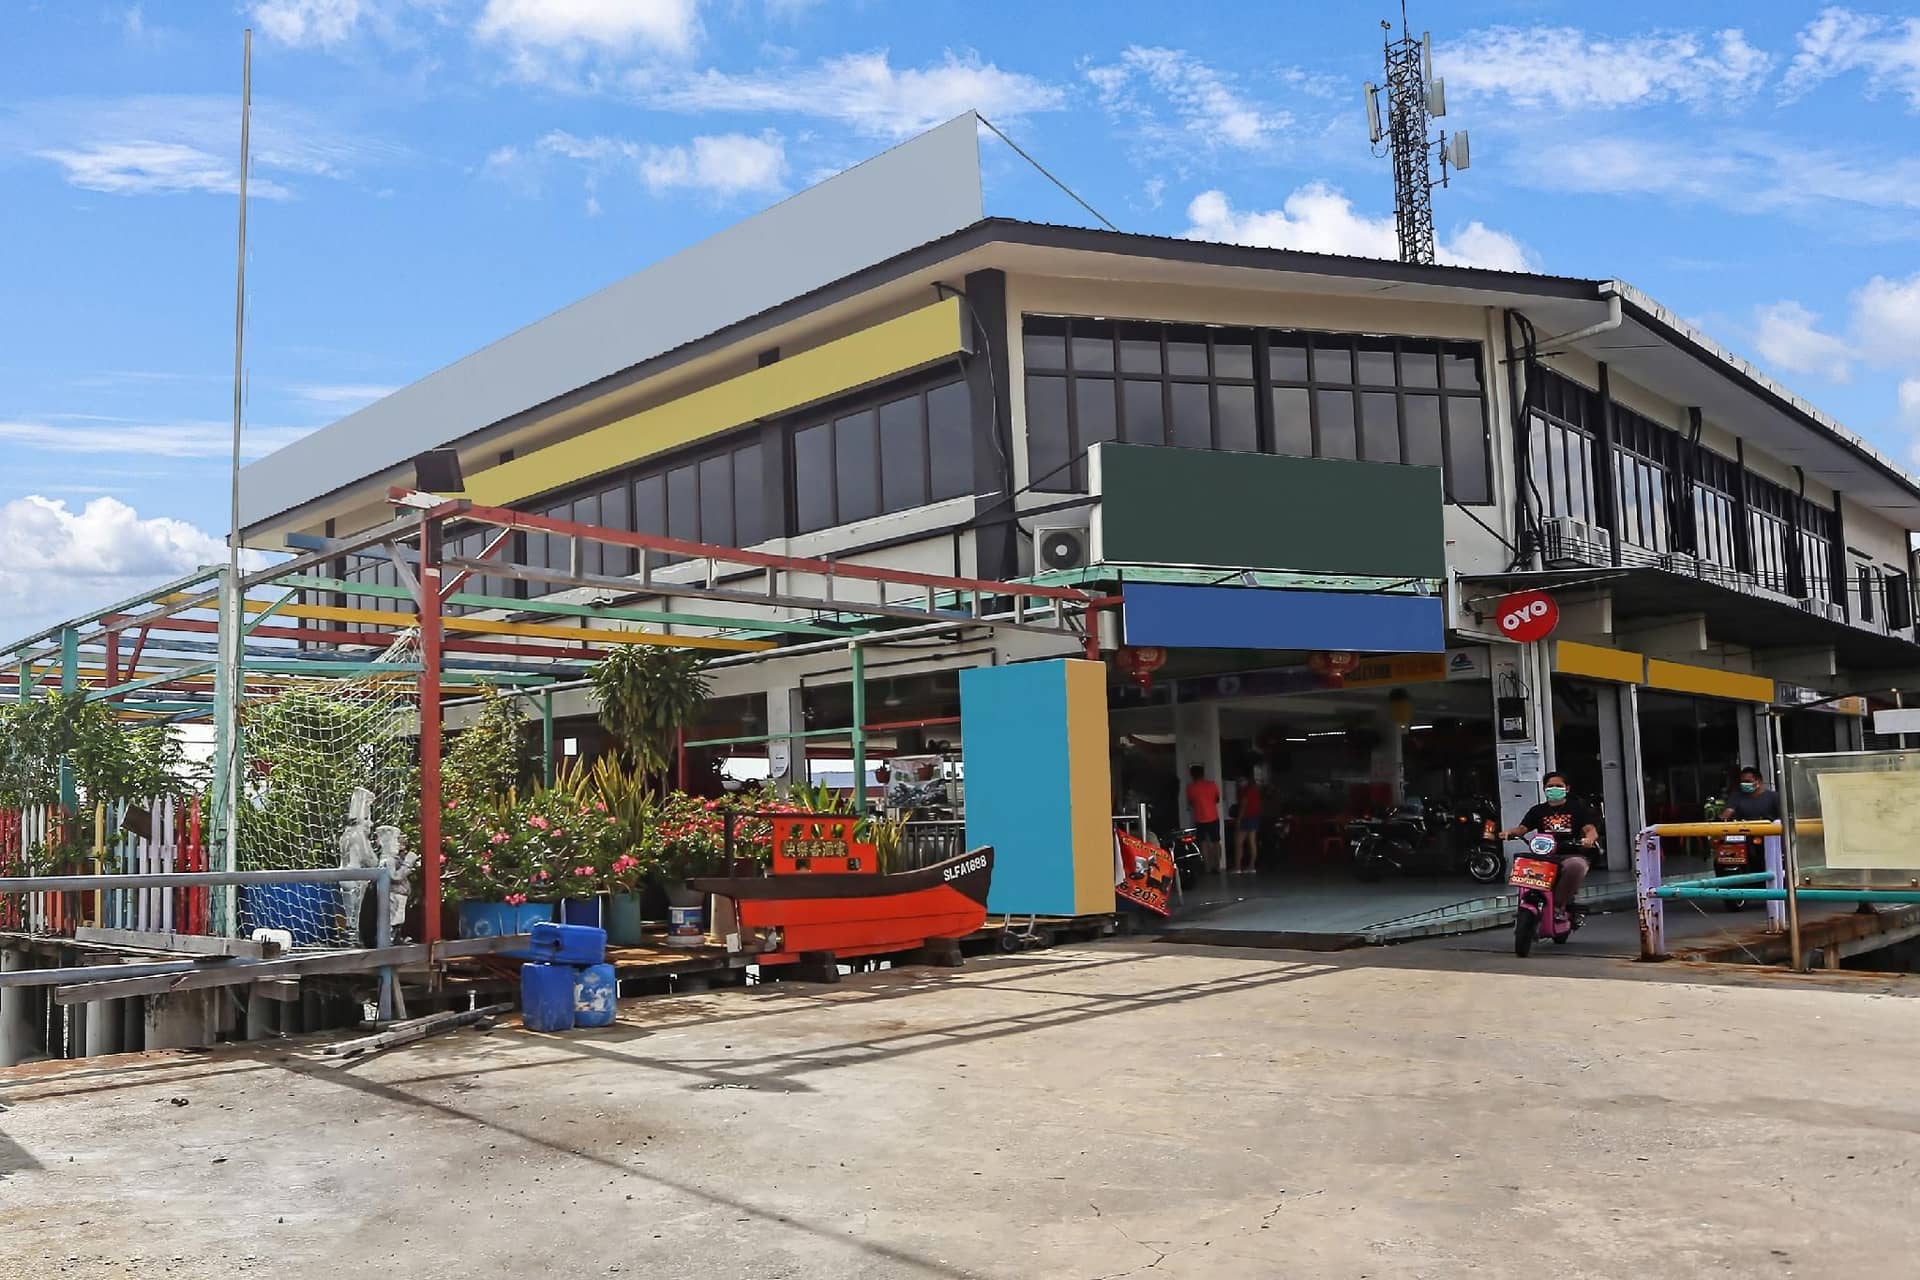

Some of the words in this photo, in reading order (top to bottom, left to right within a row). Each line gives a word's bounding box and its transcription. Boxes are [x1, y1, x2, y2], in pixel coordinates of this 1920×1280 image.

[1503, 600, 1547, 630] OYO
[943, 854, 987, 881] SLFA1688
[1132, 887, 1158, 903] 207
